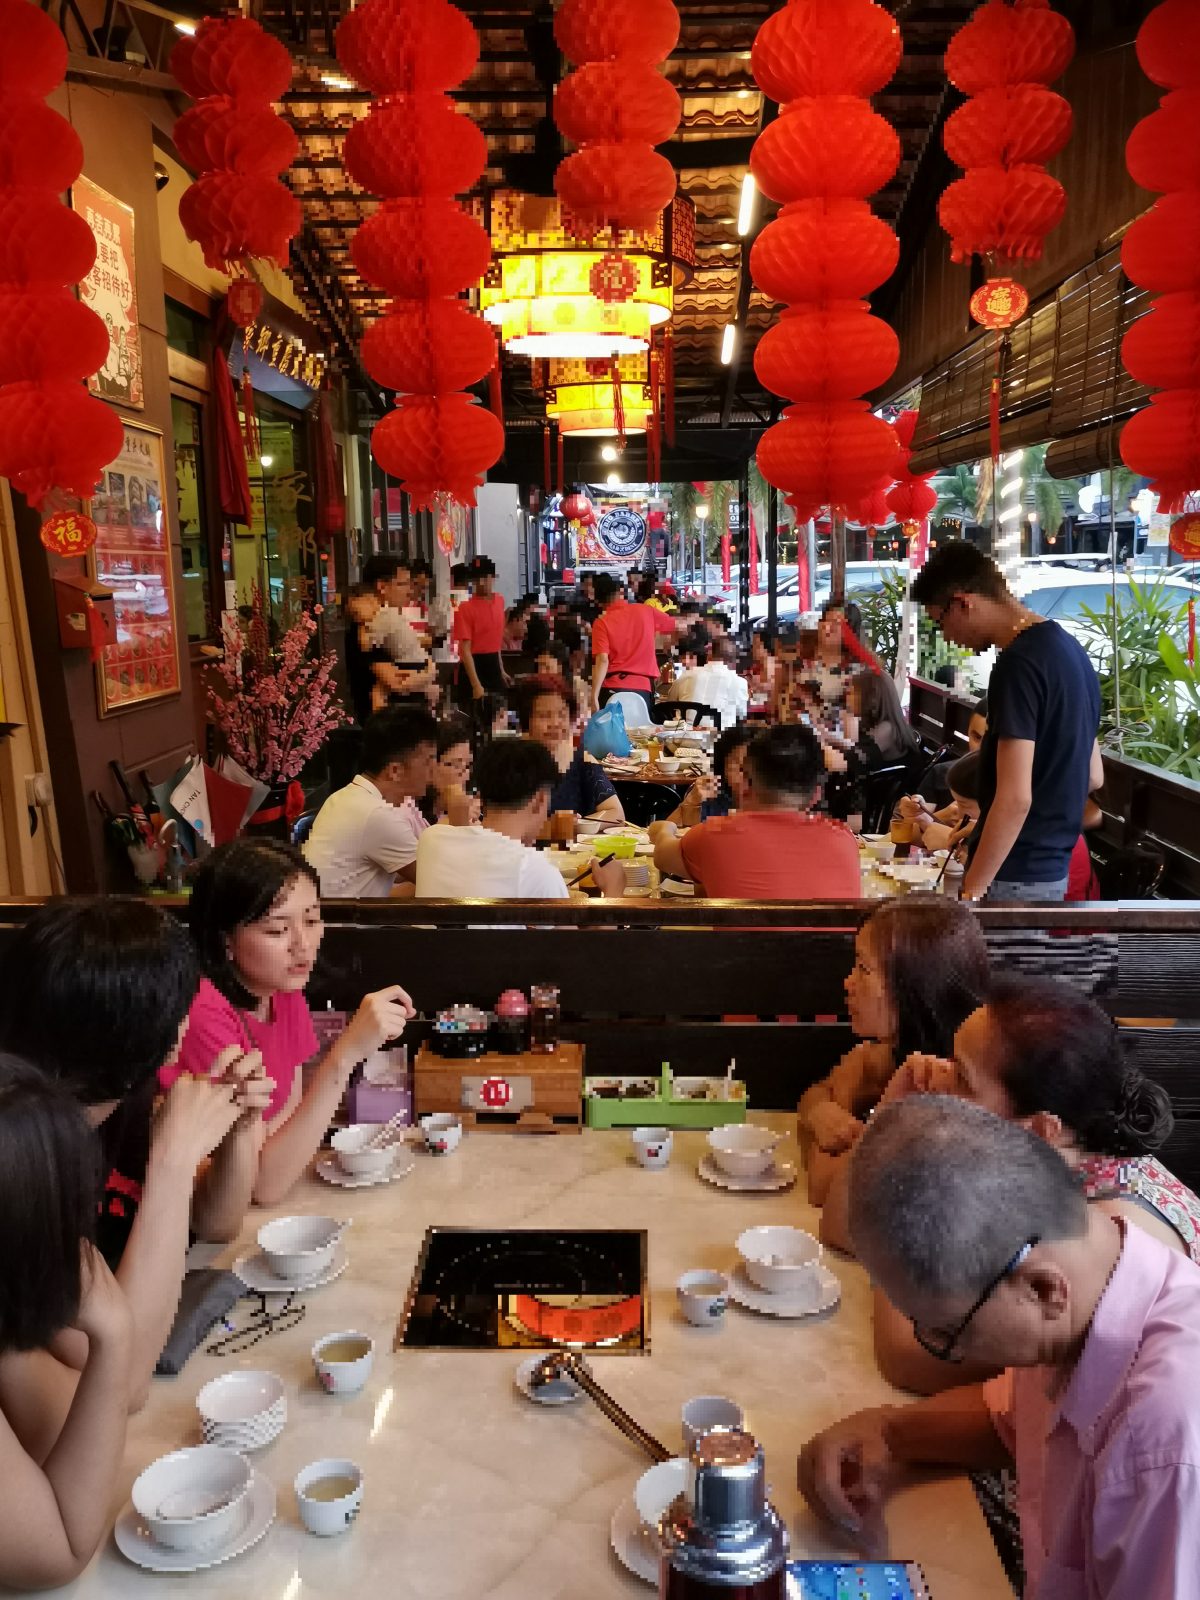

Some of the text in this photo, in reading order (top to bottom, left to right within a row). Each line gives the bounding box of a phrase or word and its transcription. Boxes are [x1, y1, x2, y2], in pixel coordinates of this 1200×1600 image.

[87, 264, 130, 302] 客招待好
[52, 517, 82, 545] 福
[188, 789, 201, 802] TAN
